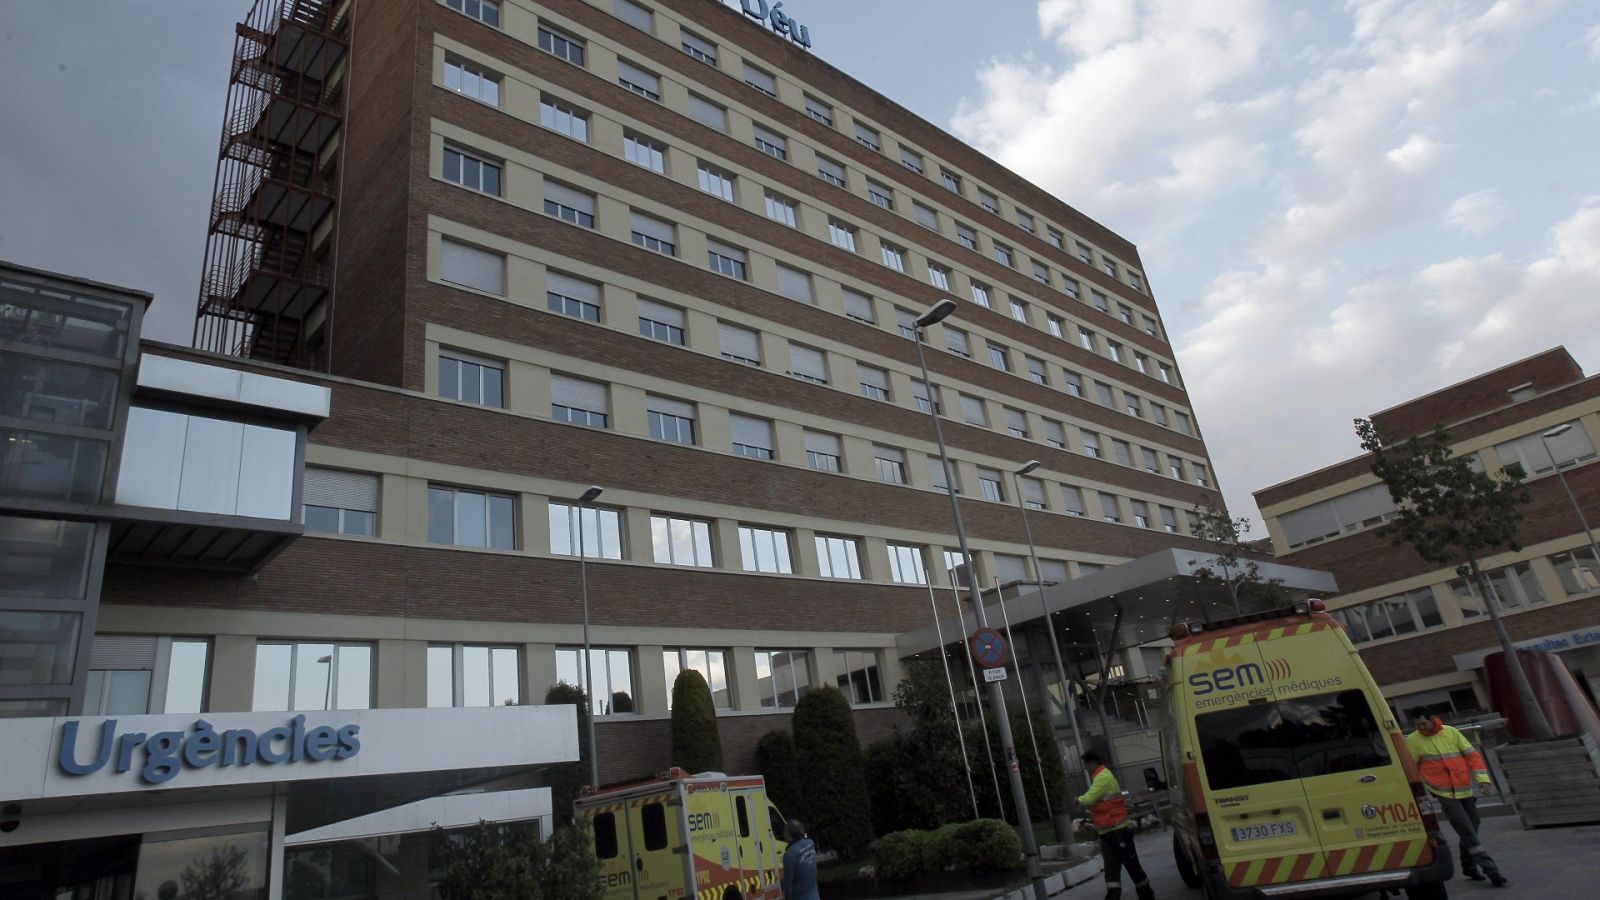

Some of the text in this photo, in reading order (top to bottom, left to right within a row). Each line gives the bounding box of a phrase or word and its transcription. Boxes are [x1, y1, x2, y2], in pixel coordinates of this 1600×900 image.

[1188, 662, 1264, 696] sem
[1195, 675, 1343, 709] emergències mèdiques
[59, 713, 361, 784] Urgències
[687, 812, 713, 832] sem
[1376, 802, 1419, 824] Y104
[1239, 822, 1294, 840] 3730 FXS
